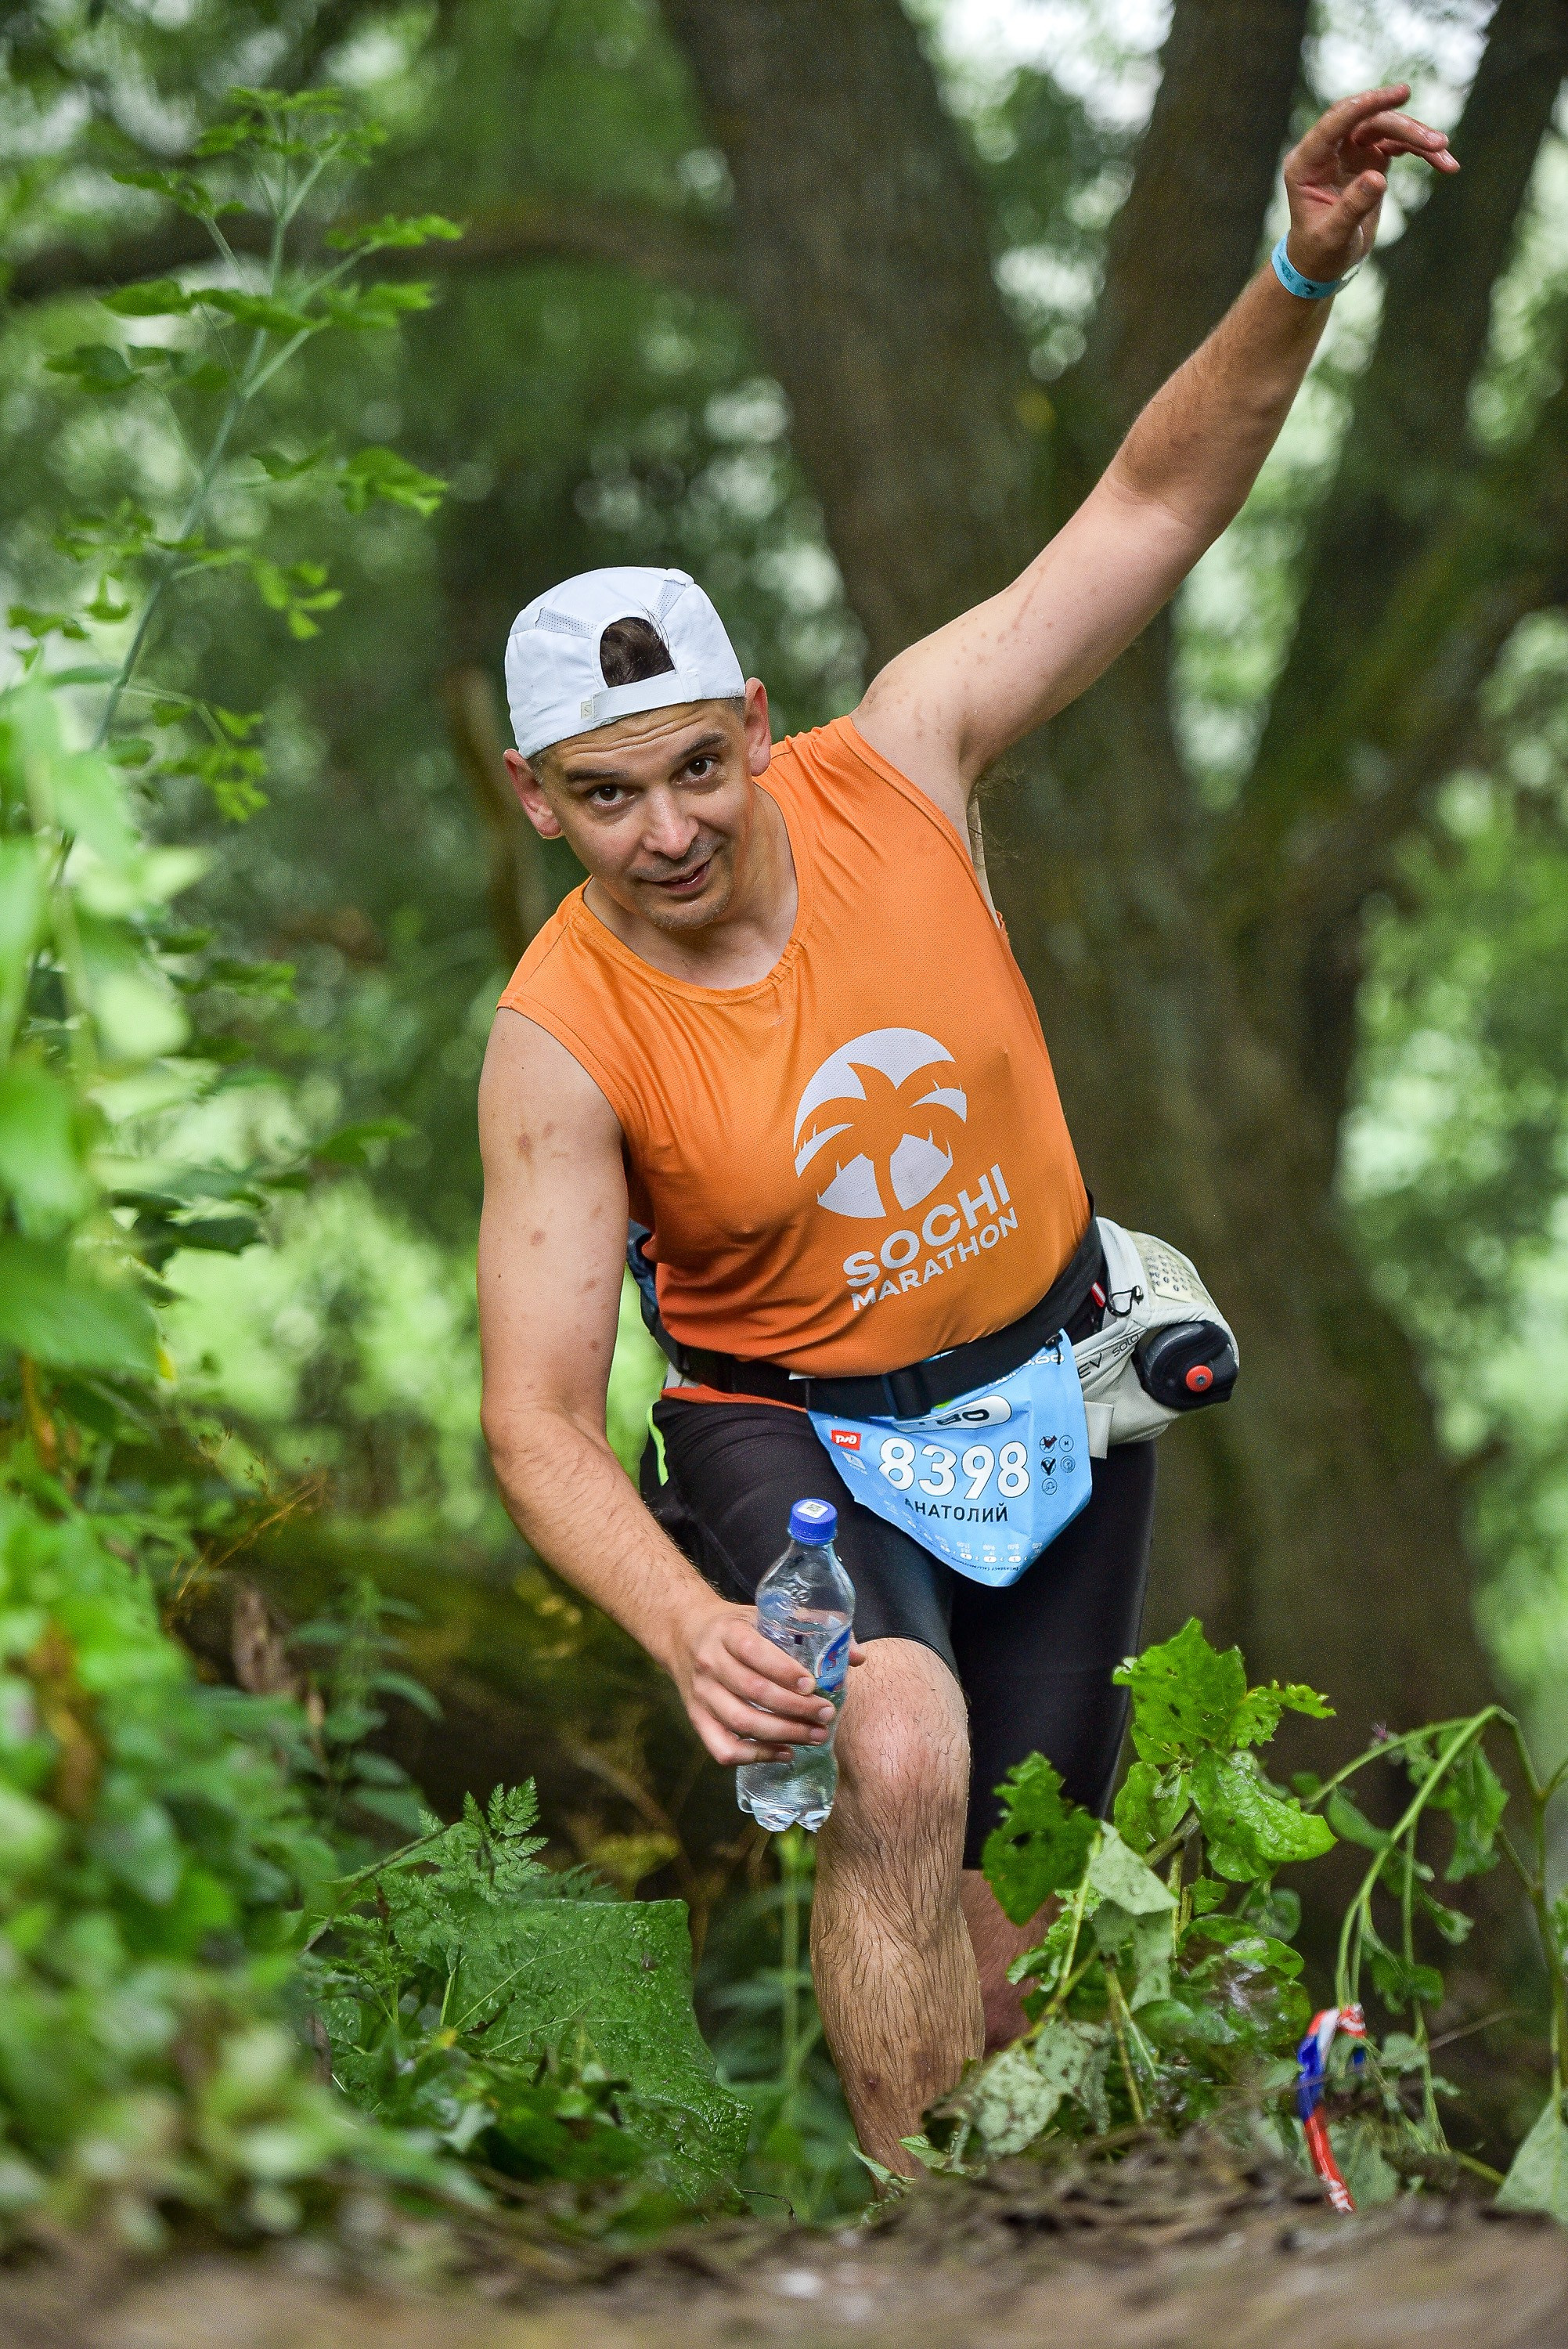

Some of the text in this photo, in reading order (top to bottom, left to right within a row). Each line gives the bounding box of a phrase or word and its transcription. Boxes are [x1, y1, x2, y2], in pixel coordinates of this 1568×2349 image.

[843, 1164, 1011, 1287] SOCHI
[851, 1207, 1018, 1312] MARATHON
[1076, 1352, 1102, 1379] EV
[878, 1437, 1030, 1500] 8398
